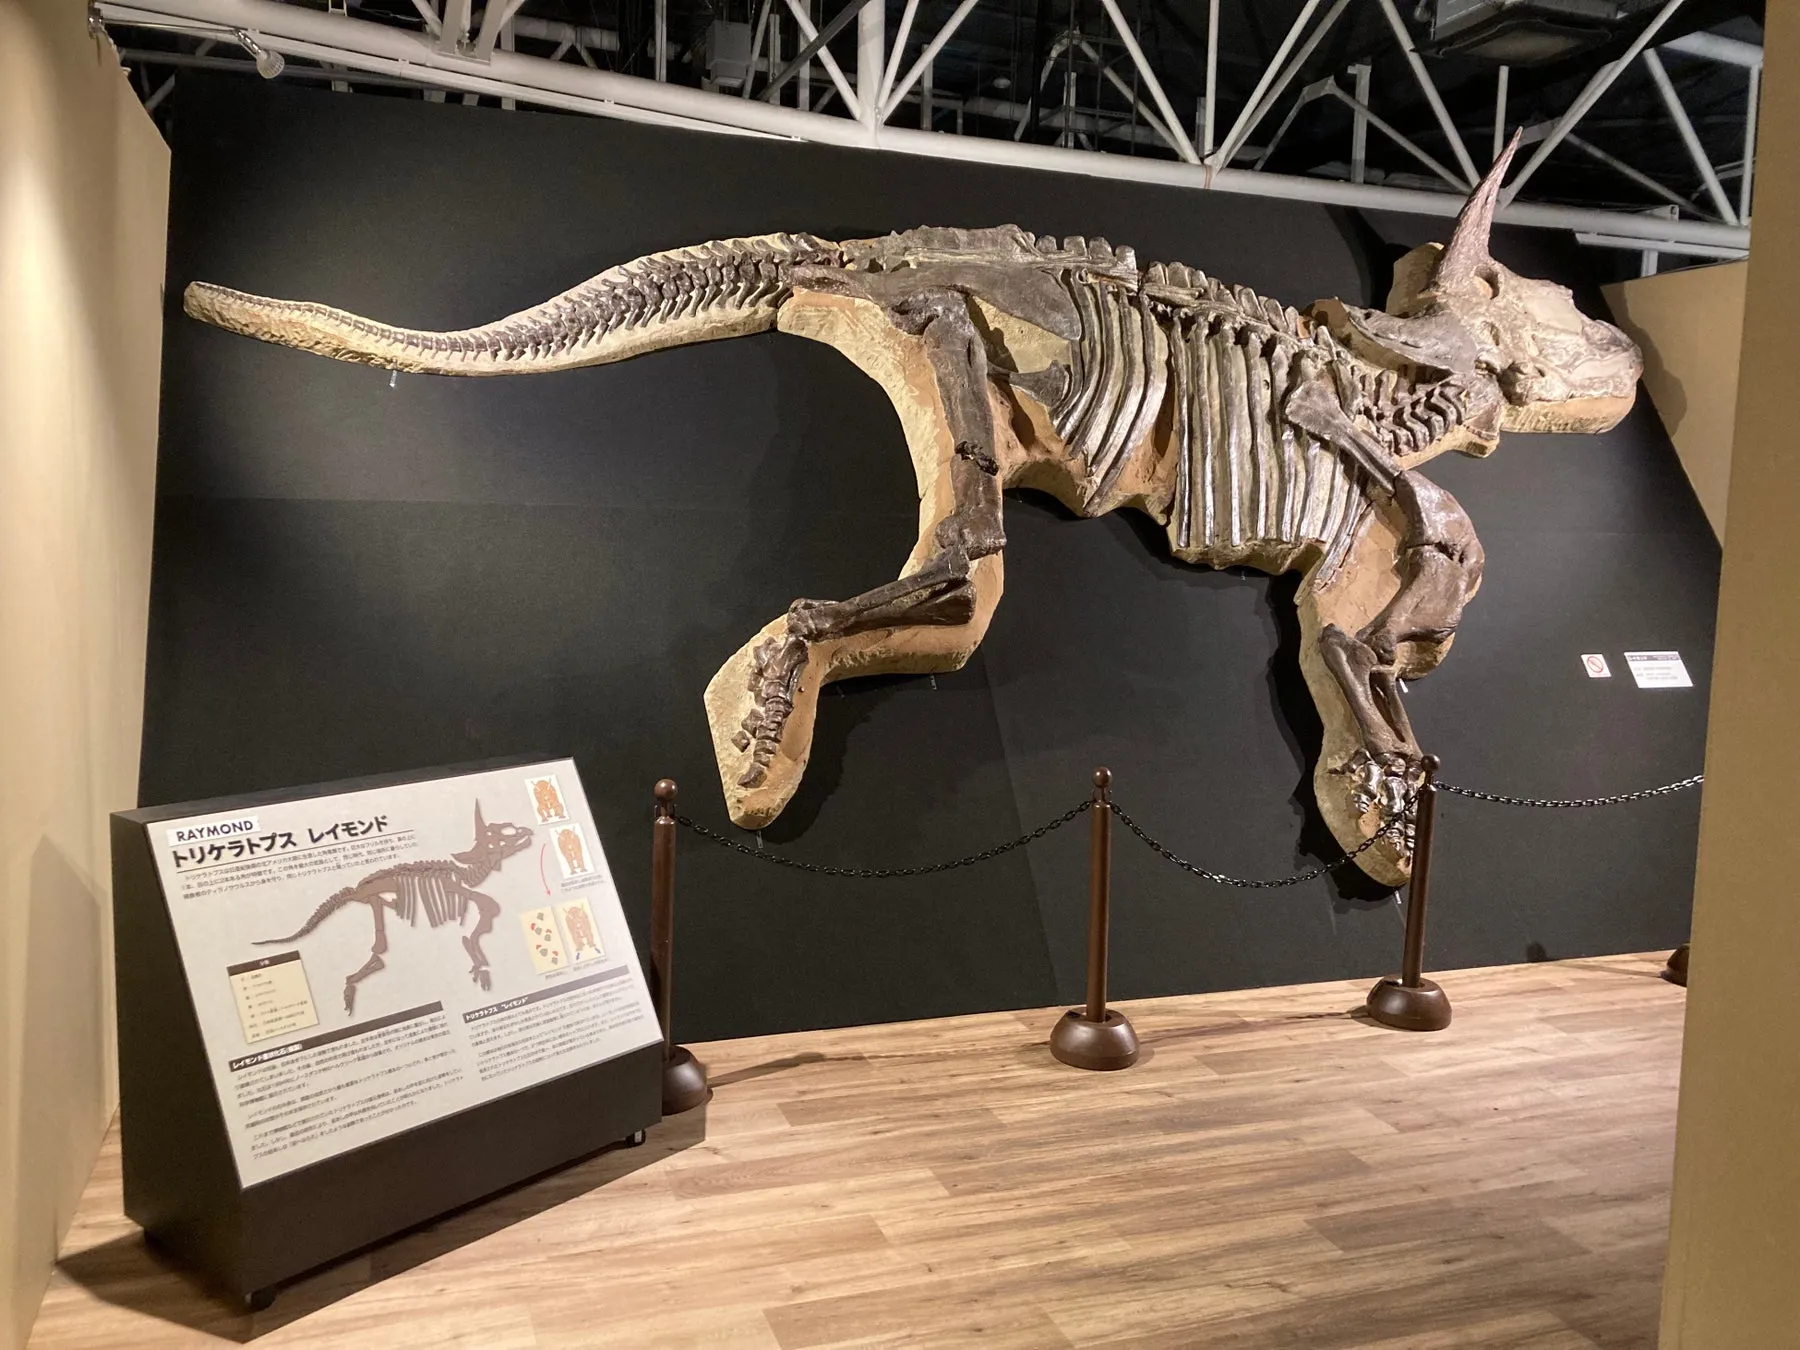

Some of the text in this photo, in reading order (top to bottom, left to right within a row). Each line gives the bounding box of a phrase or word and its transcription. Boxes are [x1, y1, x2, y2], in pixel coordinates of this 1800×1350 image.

[173, 815, 388, 868] トリケラトプス レイモンド
[177, 820, 254, 842] RAYMOND
